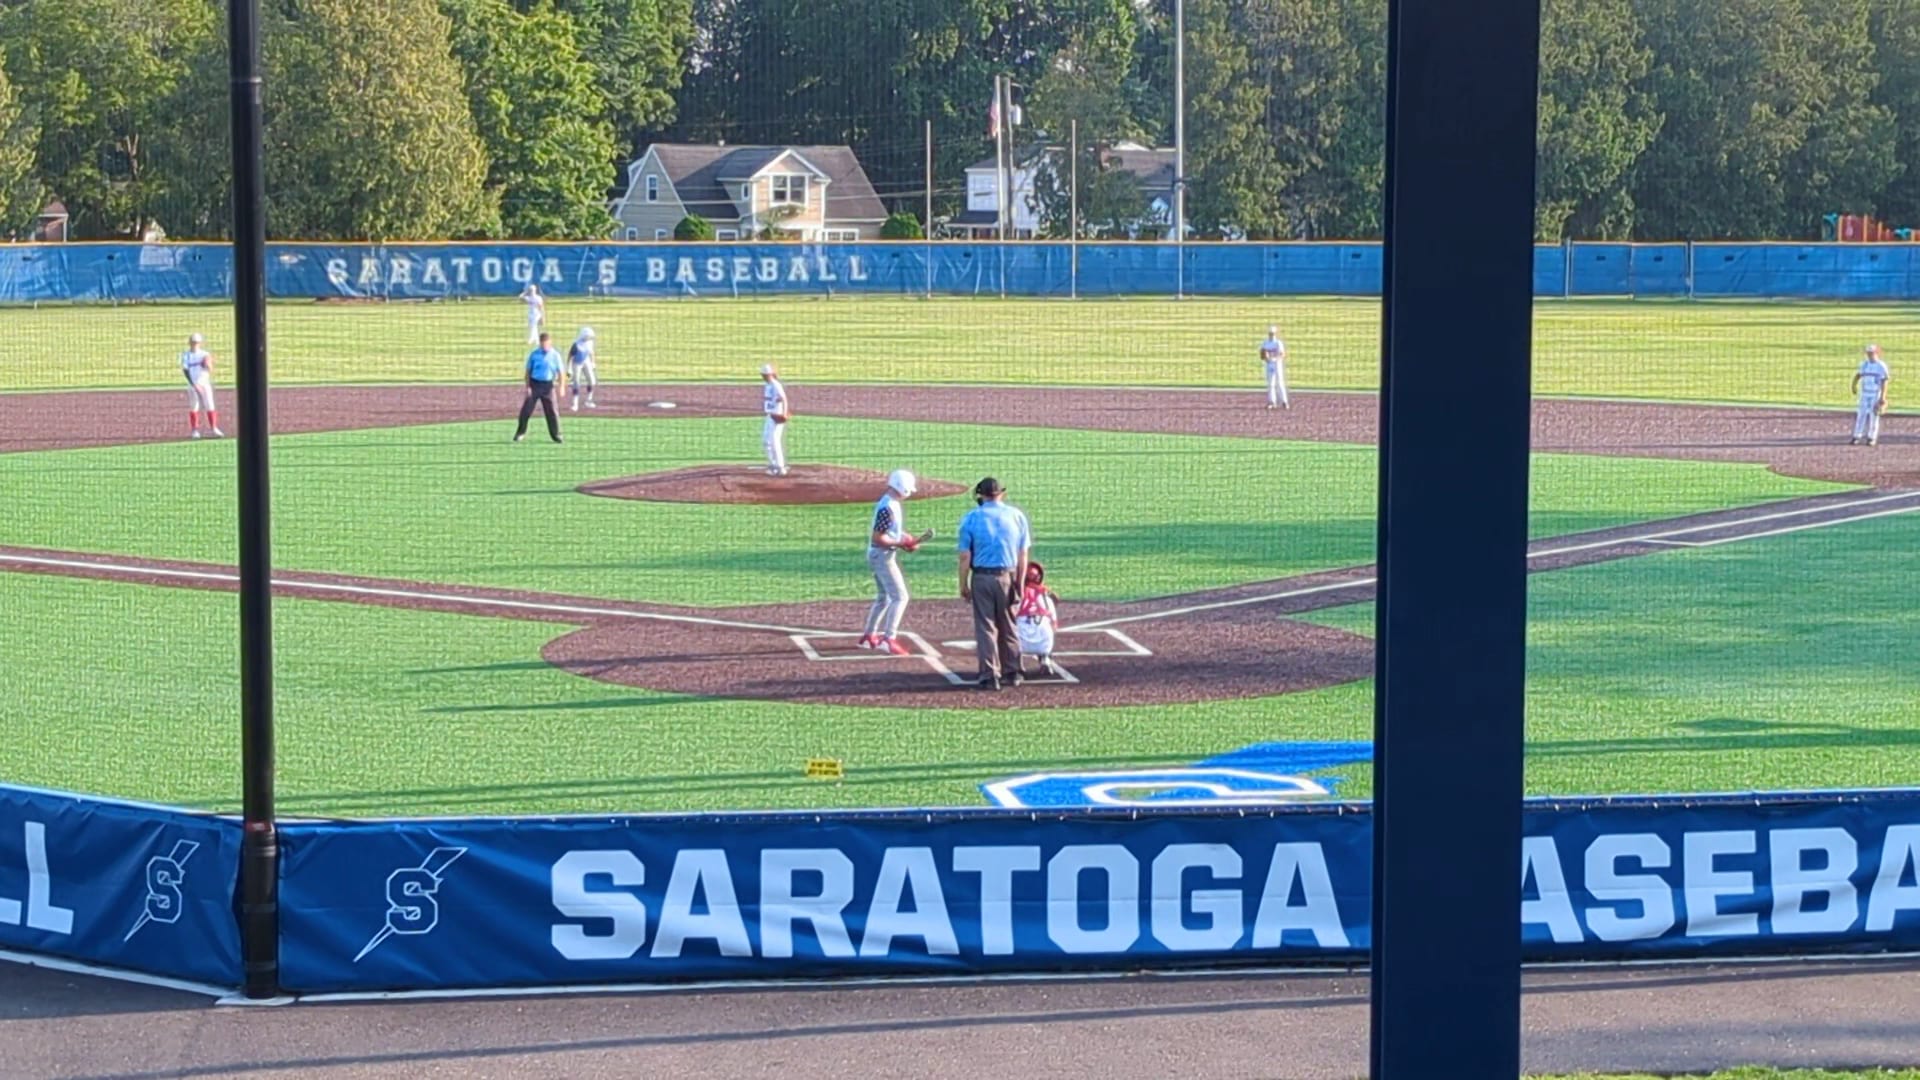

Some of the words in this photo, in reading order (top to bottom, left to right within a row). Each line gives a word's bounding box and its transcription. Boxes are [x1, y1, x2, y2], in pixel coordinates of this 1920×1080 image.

[327, 256, 563, 285] SARATOGA
[599, 257, 617, 285] S
[647, 255, 867, 283] BASEBALL
[551, 842, 1350, 960] SARATOGA
[1521, 825, 1920, 943] ASEBA
